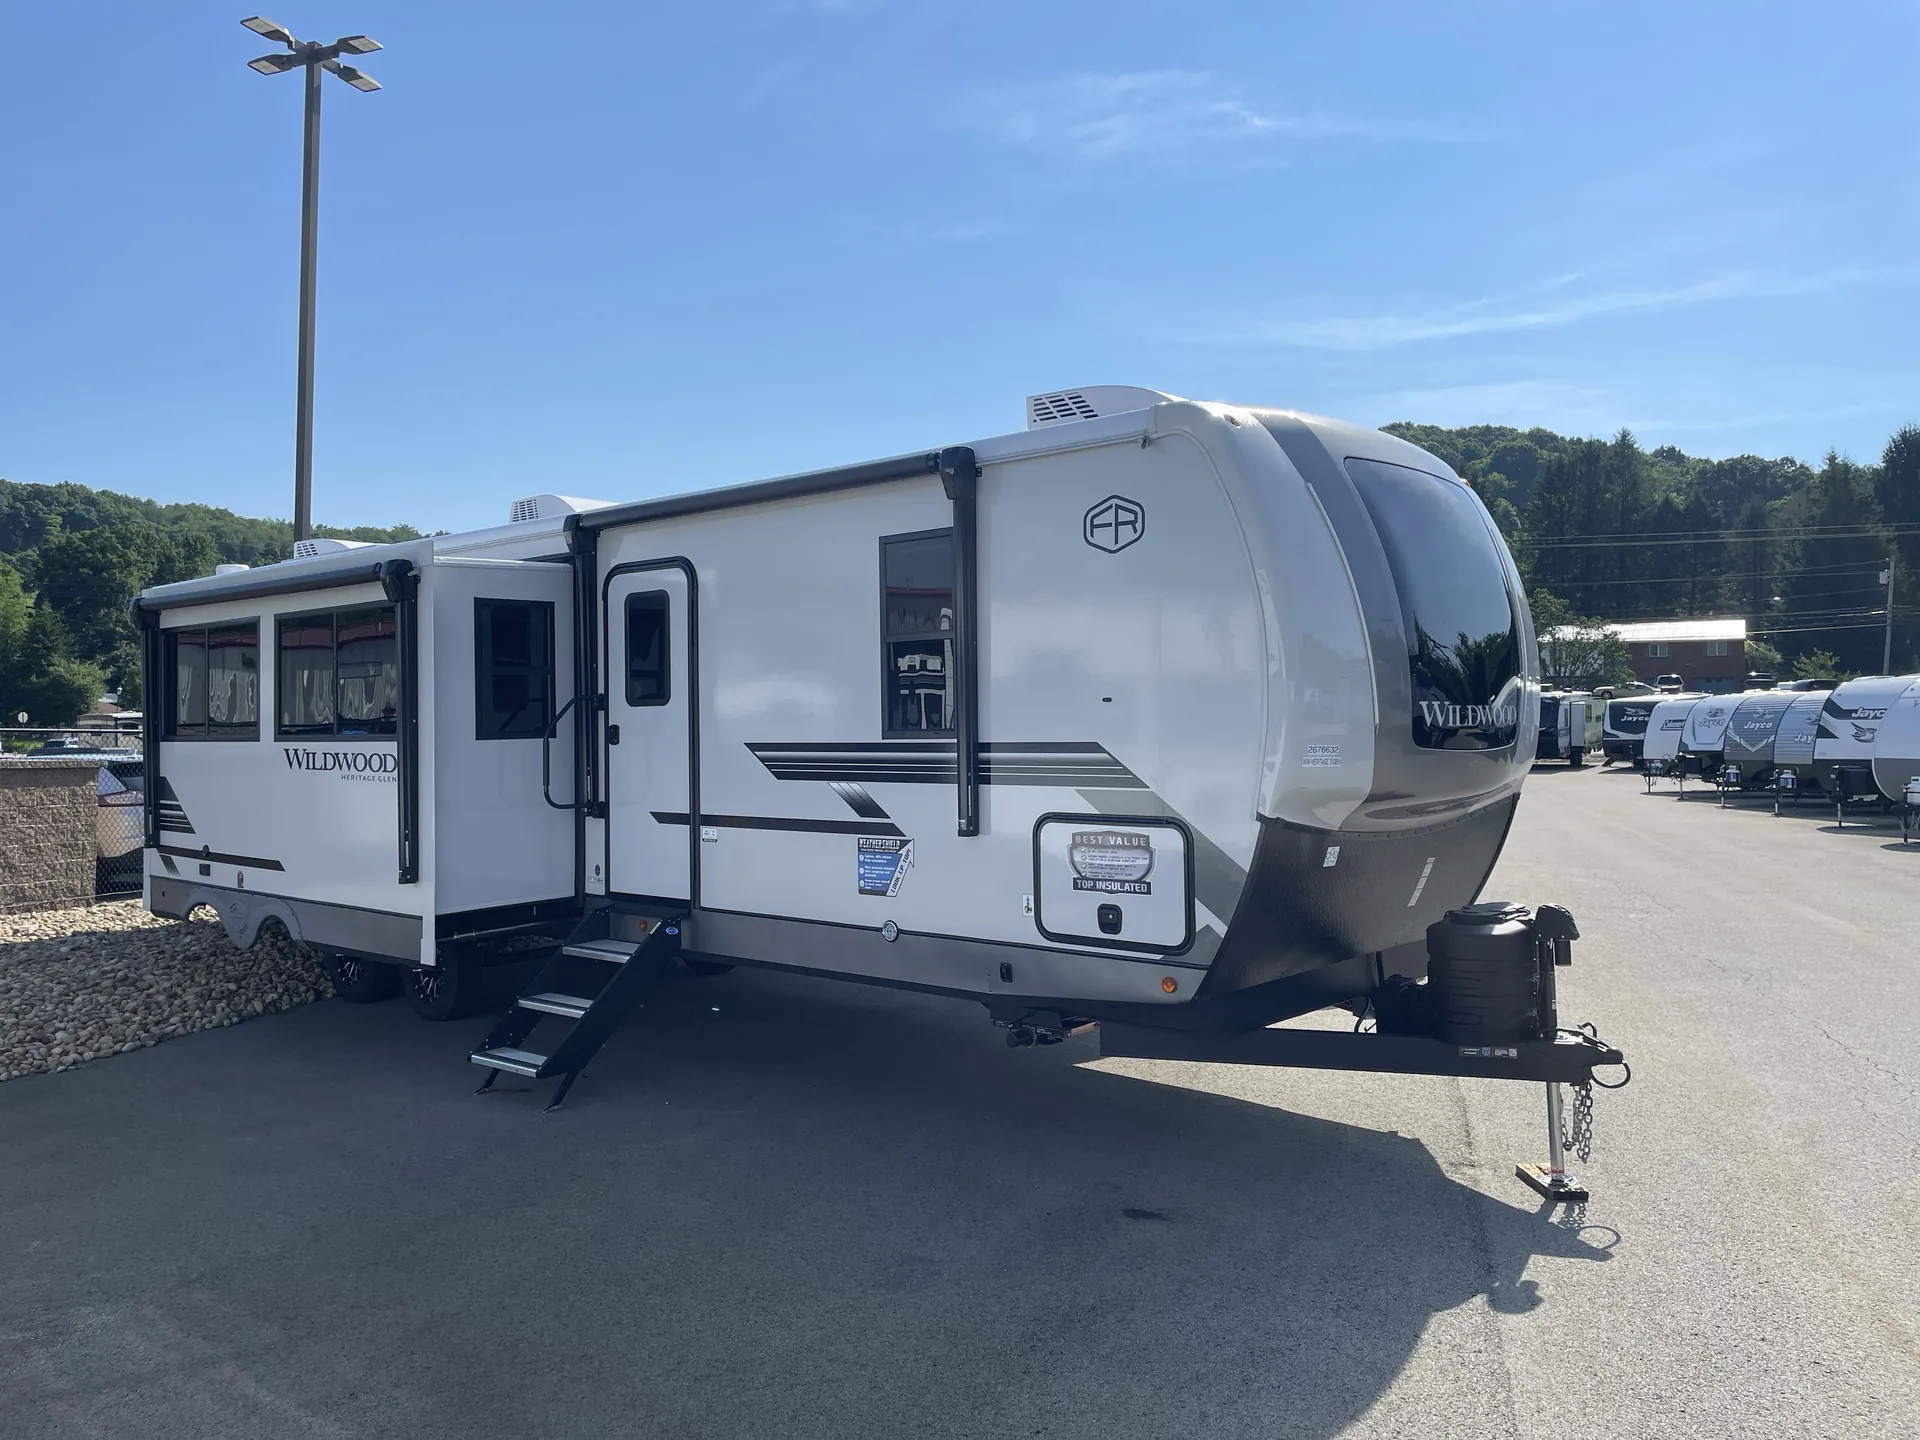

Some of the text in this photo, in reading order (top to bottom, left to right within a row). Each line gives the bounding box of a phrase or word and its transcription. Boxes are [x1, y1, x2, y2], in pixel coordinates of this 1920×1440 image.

[1419, 700, 1517, 728] WILDWOOD
[1851, 707, 1886, 719] Jayc
[1699, 718, 1725, 728] Jayco
[1743, 721, 1773, 730] Jayco
[1793, 732, 1816, 744] Jay
[1307, 745, 1339, 754] 2676632
[283, 748, 398, 773] WILDWOOD
[341, 774, 397, 783] HERITAGE GLEN
[1075, 835, 1147, 846] BEST VALUE
[890, 877, 900, 893] LOOK
[898, 864, 904, 875] UP
[1076, 879, 1148, 892] TOP INSULATED
